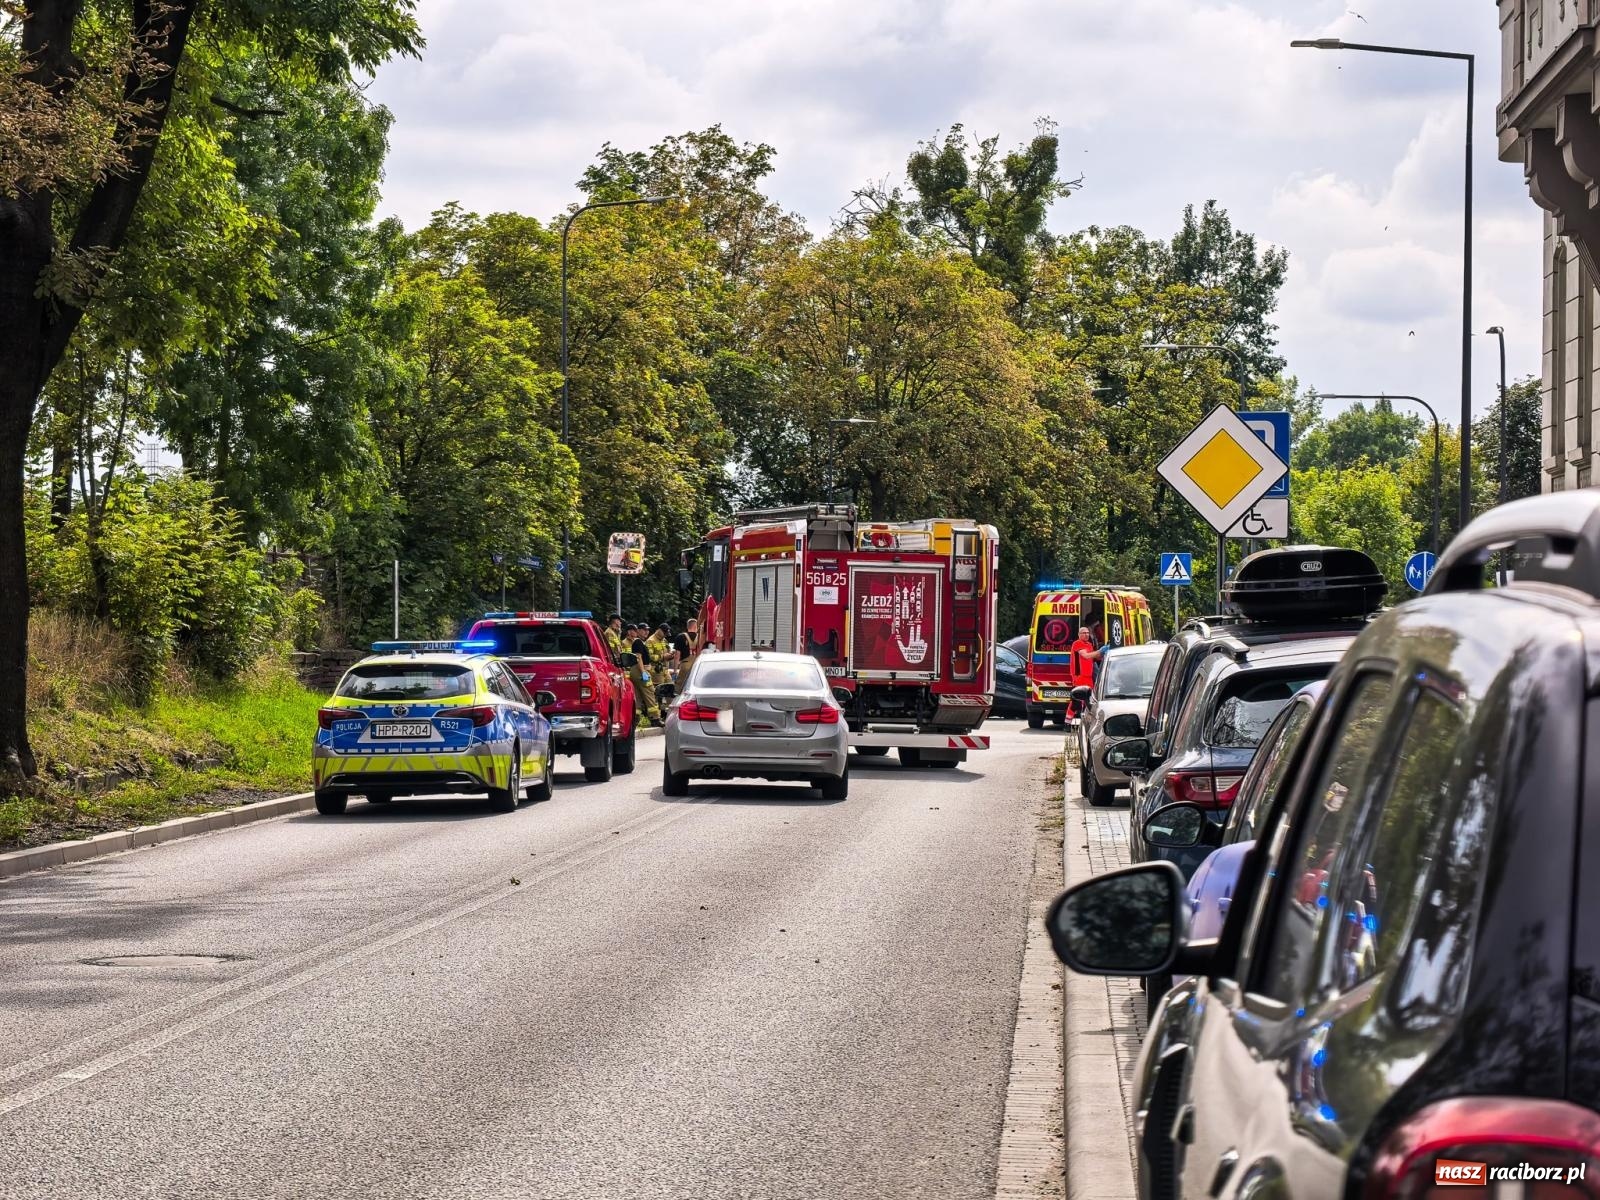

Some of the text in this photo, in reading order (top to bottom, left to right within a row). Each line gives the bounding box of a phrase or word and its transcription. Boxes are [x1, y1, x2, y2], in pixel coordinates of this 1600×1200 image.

[1302, 562, 1320, 570] CRUZ
[861, 593, 893, 607] ZJEDŹ
[423, 642, 455, 650] POLICJA
[335, 723, 362, 732] POLICJA
[440, 720, 459, 730] R521
[378, 725, 399, 736] HPP
[402, 725, 429, 736] R204
